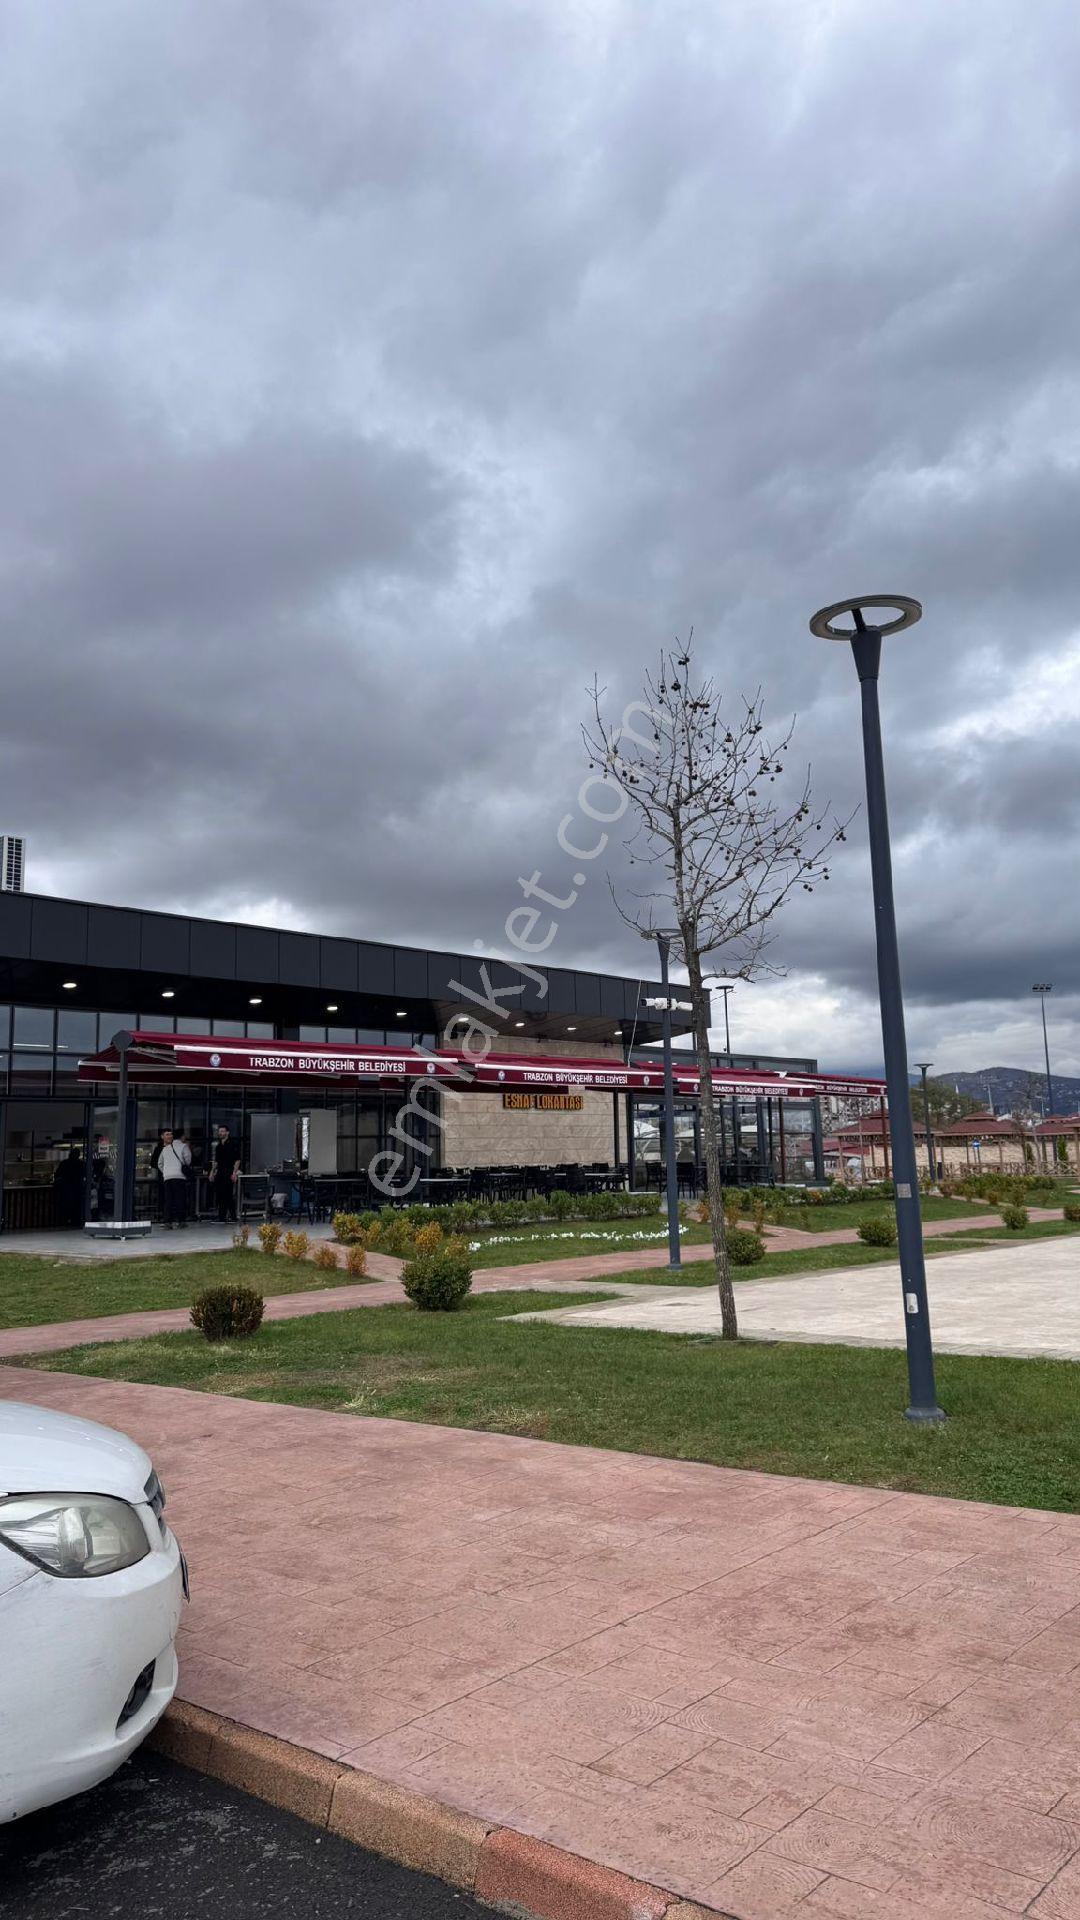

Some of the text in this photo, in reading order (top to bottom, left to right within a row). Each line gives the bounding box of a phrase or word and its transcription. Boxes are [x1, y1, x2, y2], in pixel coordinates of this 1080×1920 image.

[249, 1057, 406, 1072] TRABZON BÜYÜKŞEHİR BELEDİYESİ
[523, 1072, 553, 1082] TRABZON
[503, 1093, 535, 1109] ESNAF
